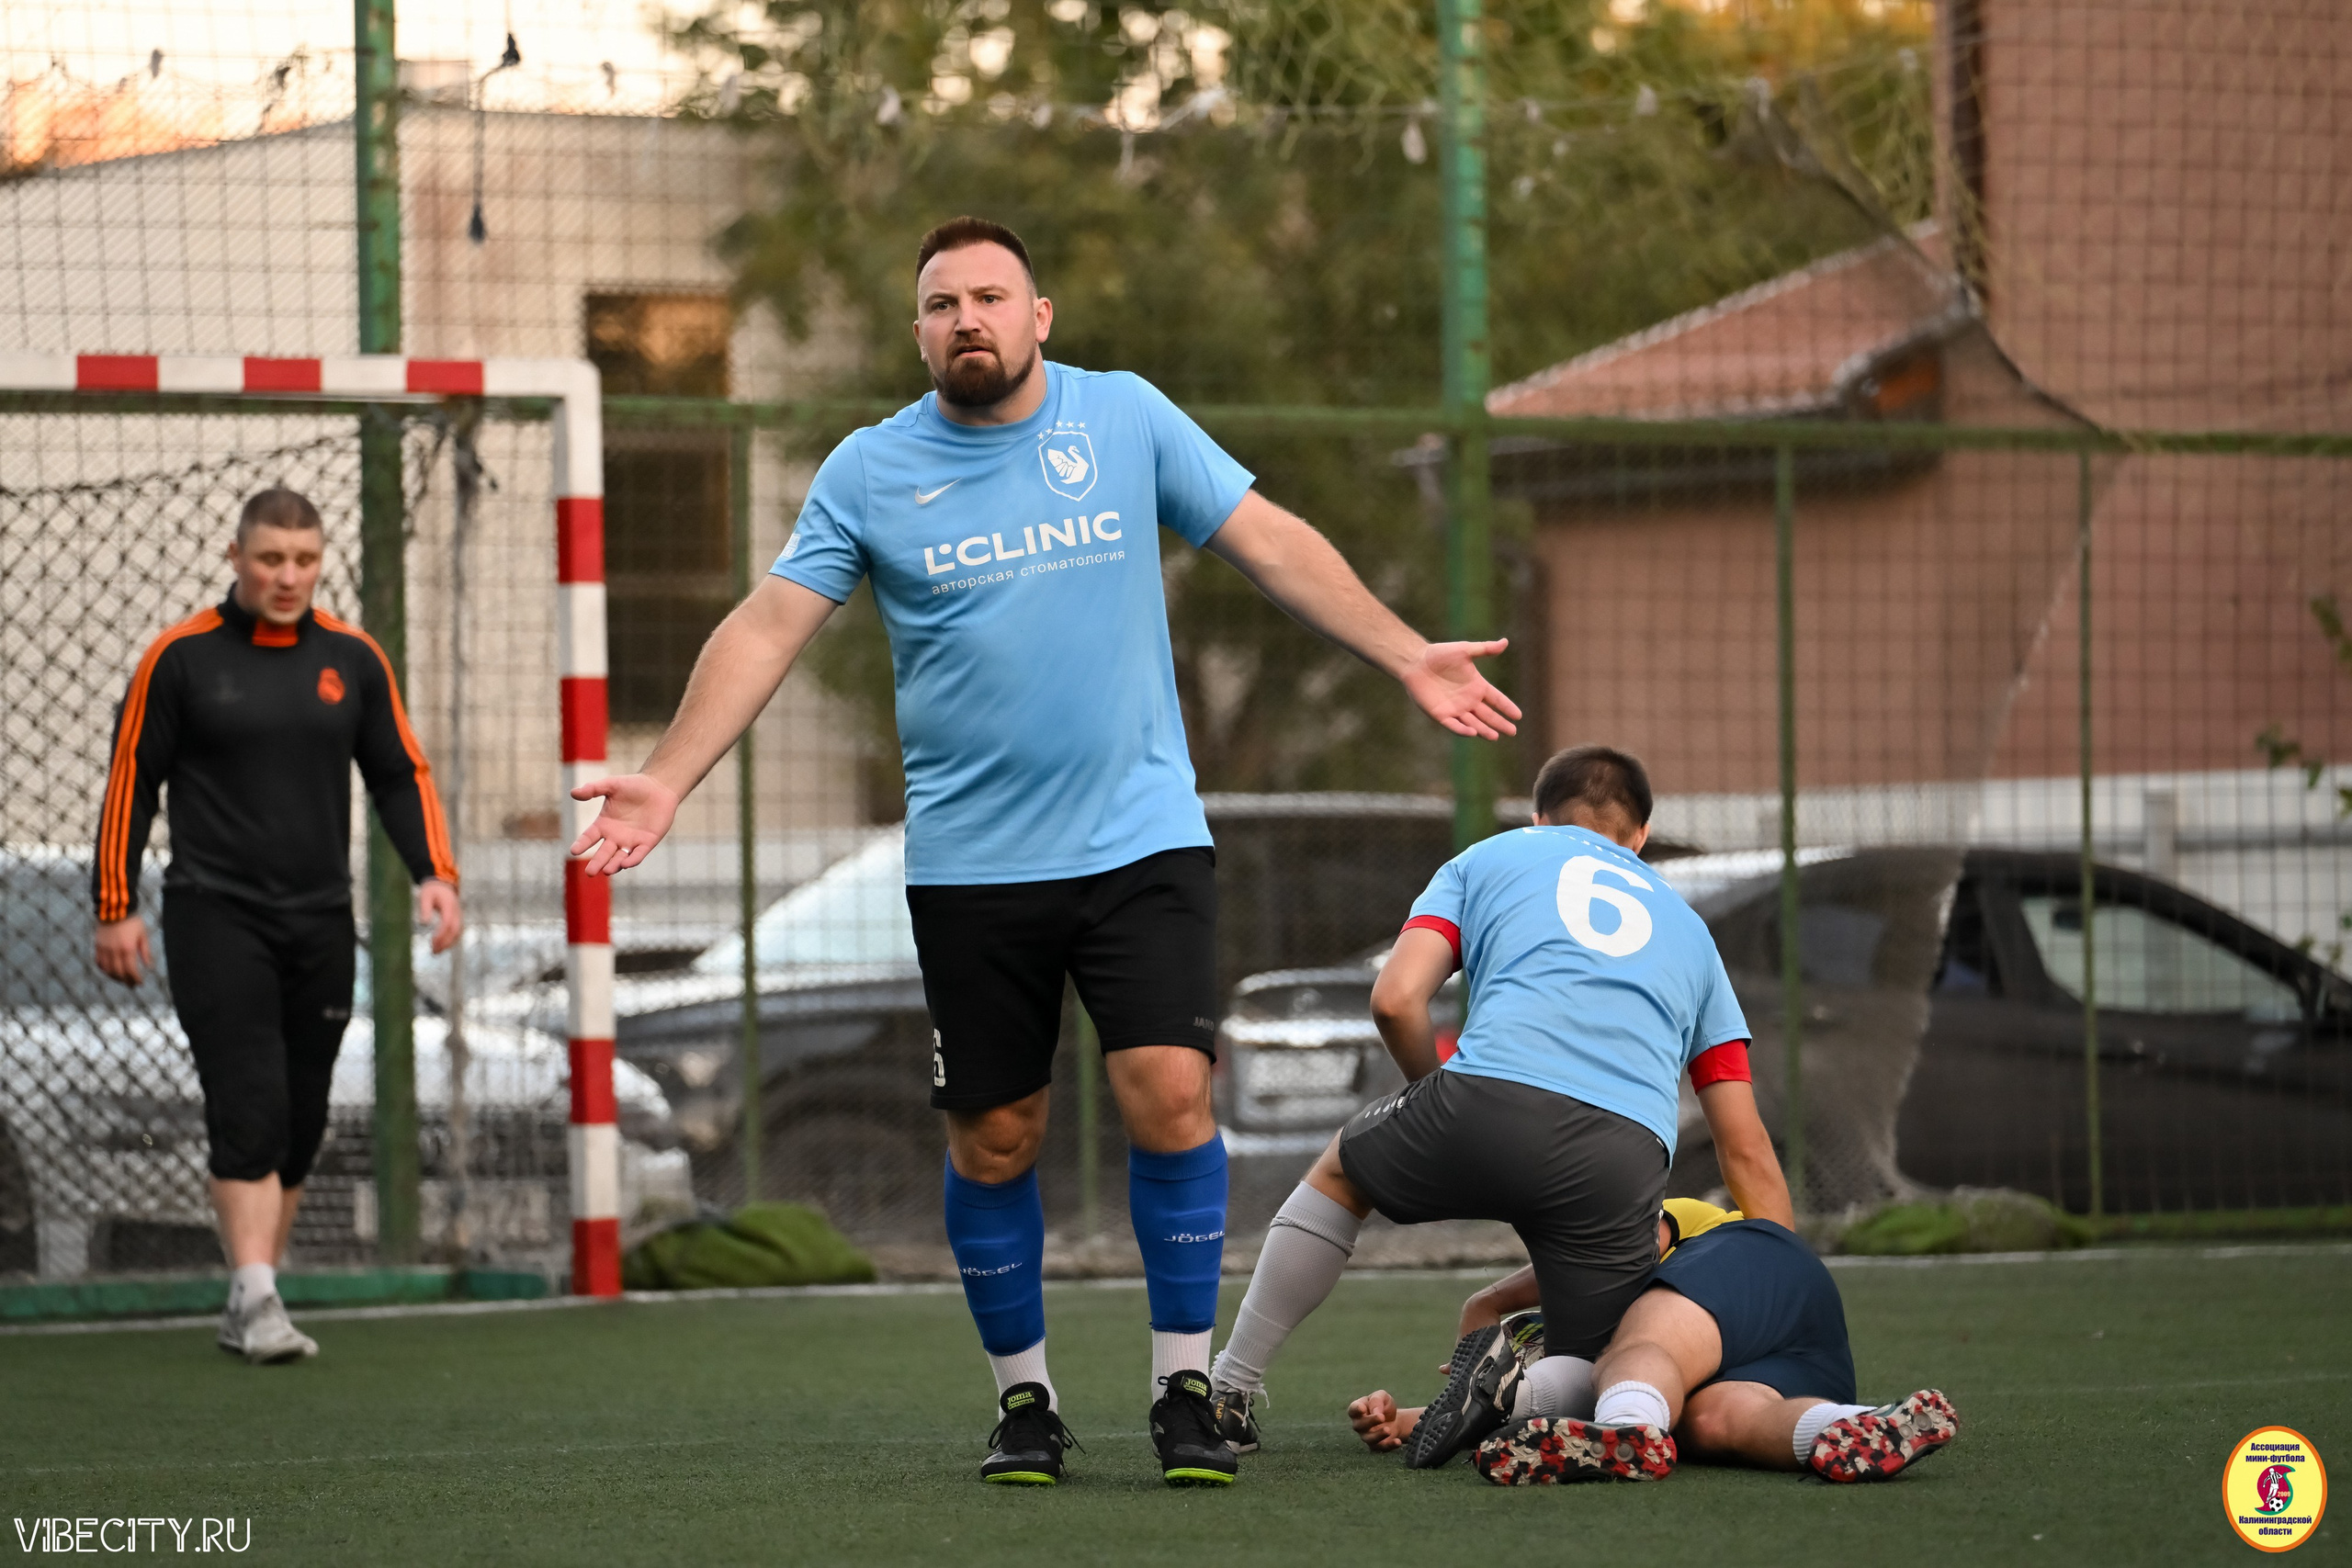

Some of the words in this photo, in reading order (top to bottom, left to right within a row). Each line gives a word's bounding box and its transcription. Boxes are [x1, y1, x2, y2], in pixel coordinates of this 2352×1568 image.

[932, 570, 1014, 595] авторская
[1020, 550, 1125, 577] стоматология
[1556, 855, 1655, 957] 6
[1193, 1016, 1215, 1032] JAKO
[1163, 1230, 1226, 1244] JÖGEL
[959, 1262, 1023, 1277] JÖGEL
[1216, 1396, 1226, 1421] TIEMP
